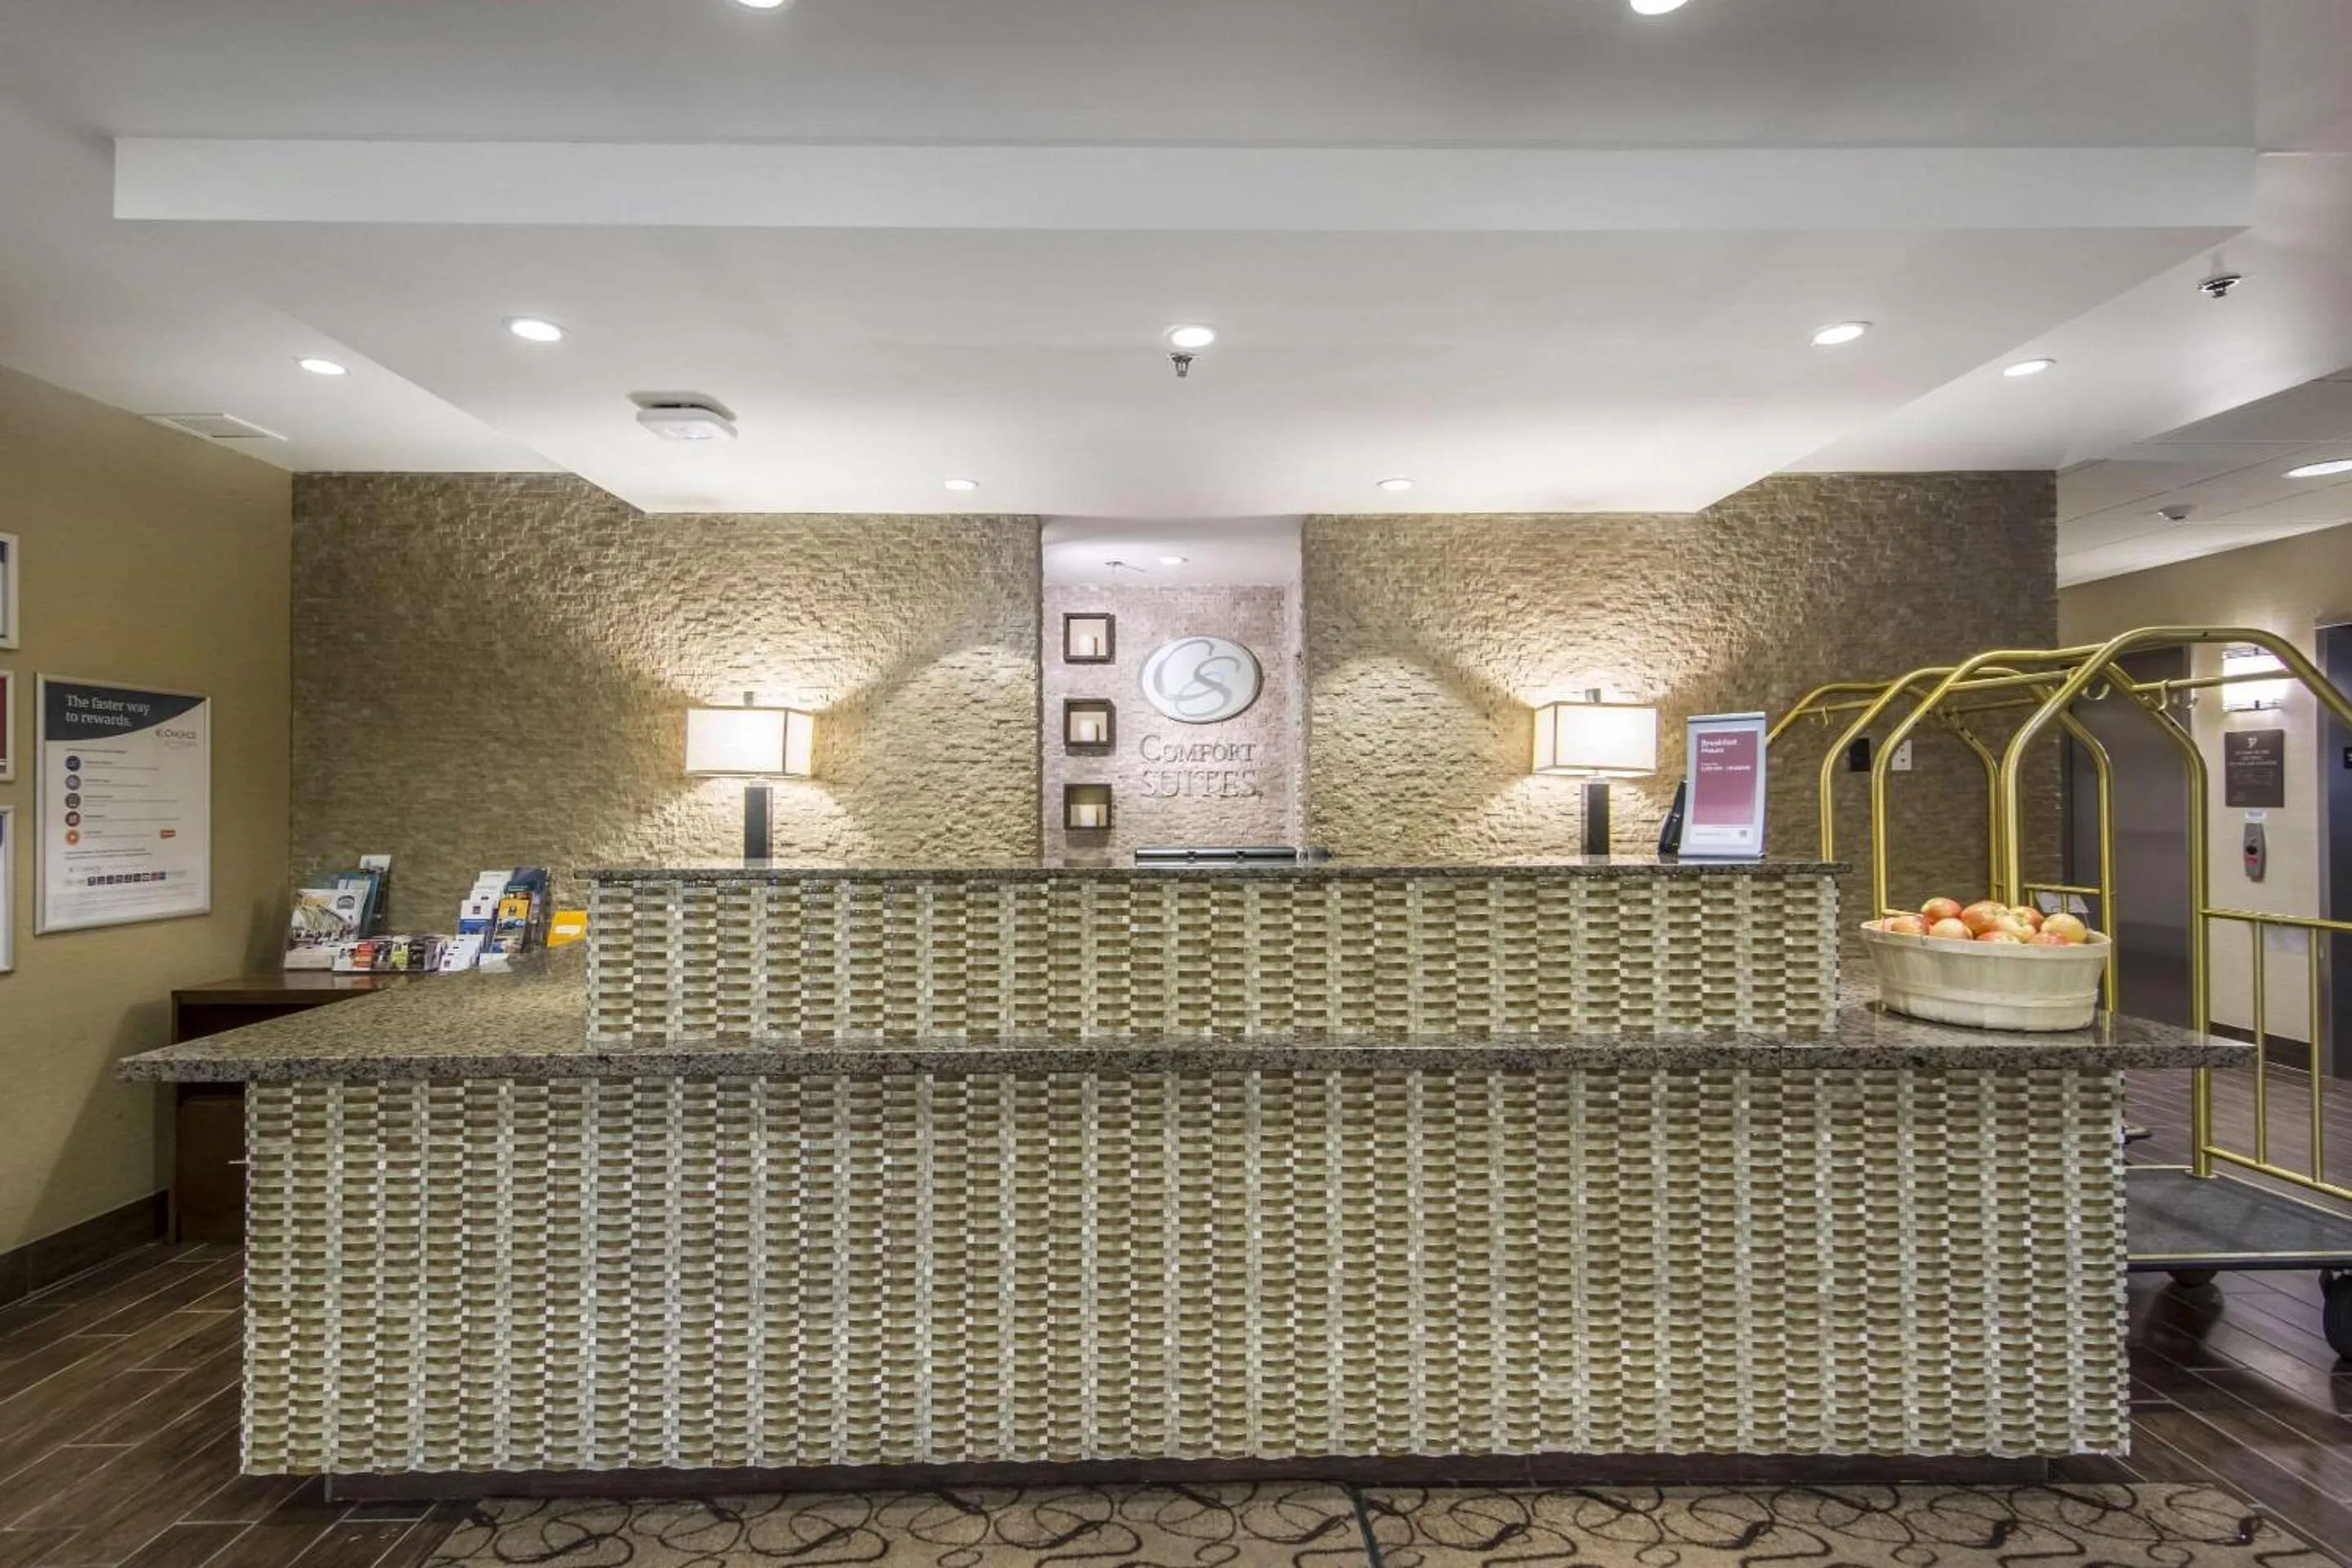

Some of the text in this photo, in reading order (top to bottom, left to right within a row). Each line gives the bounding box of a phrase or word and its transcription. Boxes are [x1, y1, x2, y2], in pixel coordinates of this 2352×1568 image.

[65, 694, 151, 716] The faster way
[65, 711, 133, 727] to rewards.
[1139, 734, 1258, 764] COMFORT
[1141, 768, 1258, 799] SUITES
